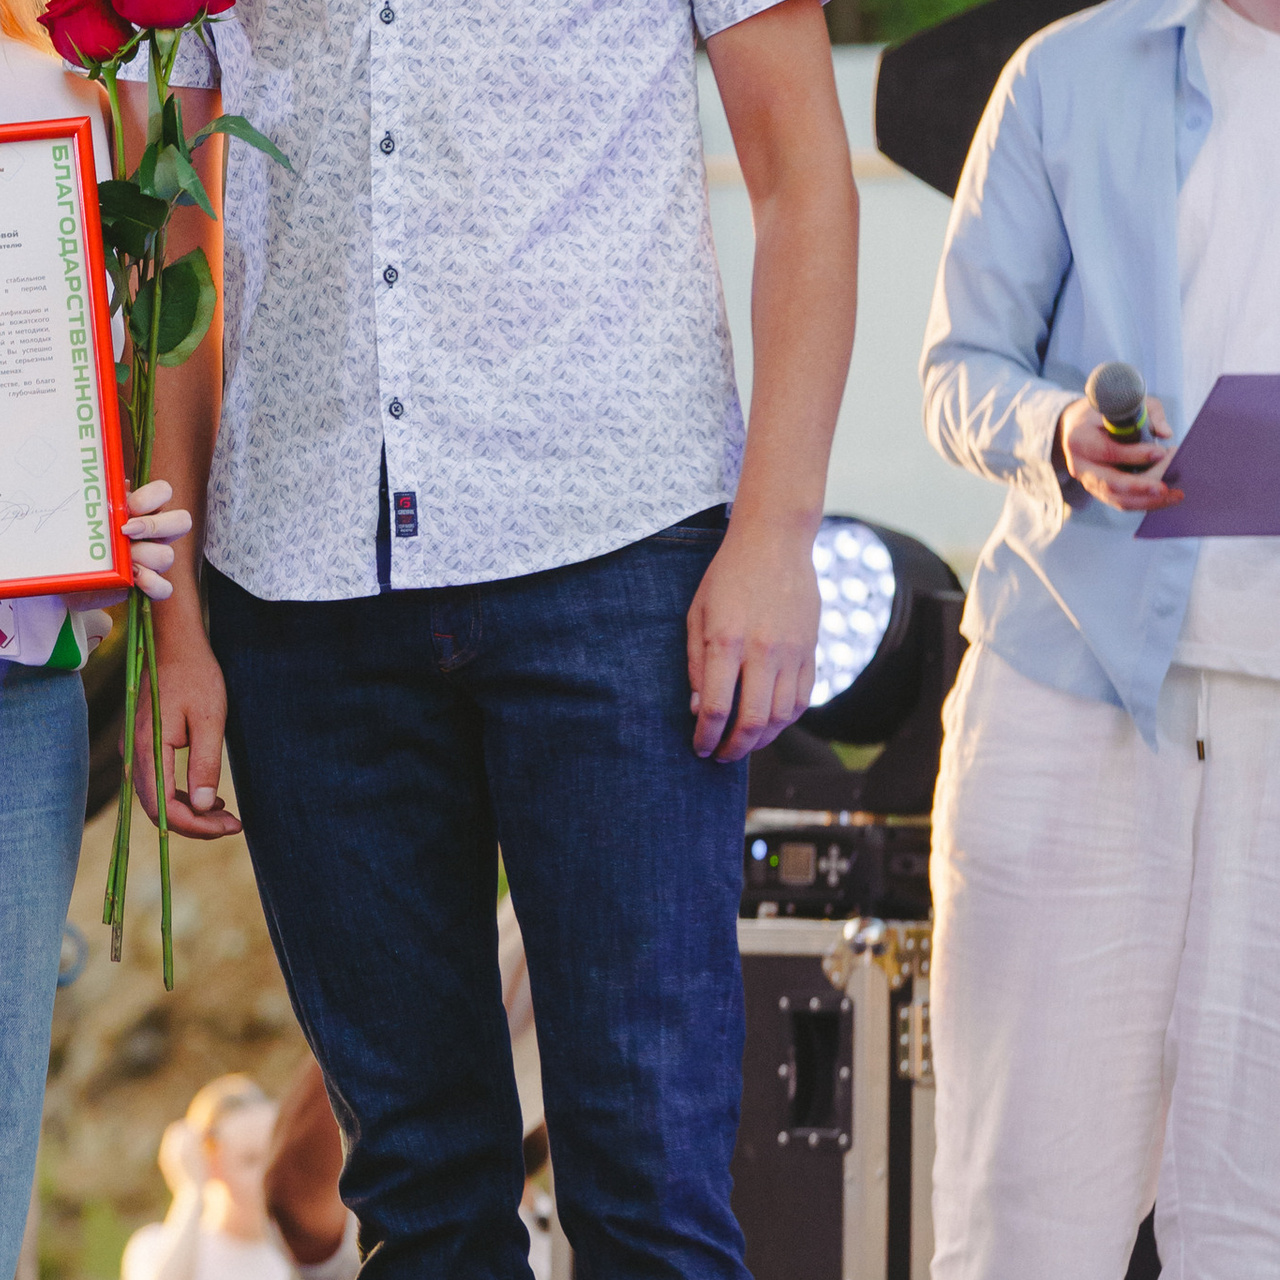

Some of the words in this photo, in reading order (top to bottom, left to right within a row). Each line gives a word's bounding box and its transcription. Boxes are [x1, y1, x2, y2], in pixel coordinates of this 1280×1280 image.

[5, 275, 46, 283] стабильное
[22, 346, 53, 354] успешно
[52, 144, 96, 440] БЛАГОДАРСТВЕННОЕ
[80, 446, 107, 561] ПИСЬМО
[8, 387, 56, 397] глубочайшим
